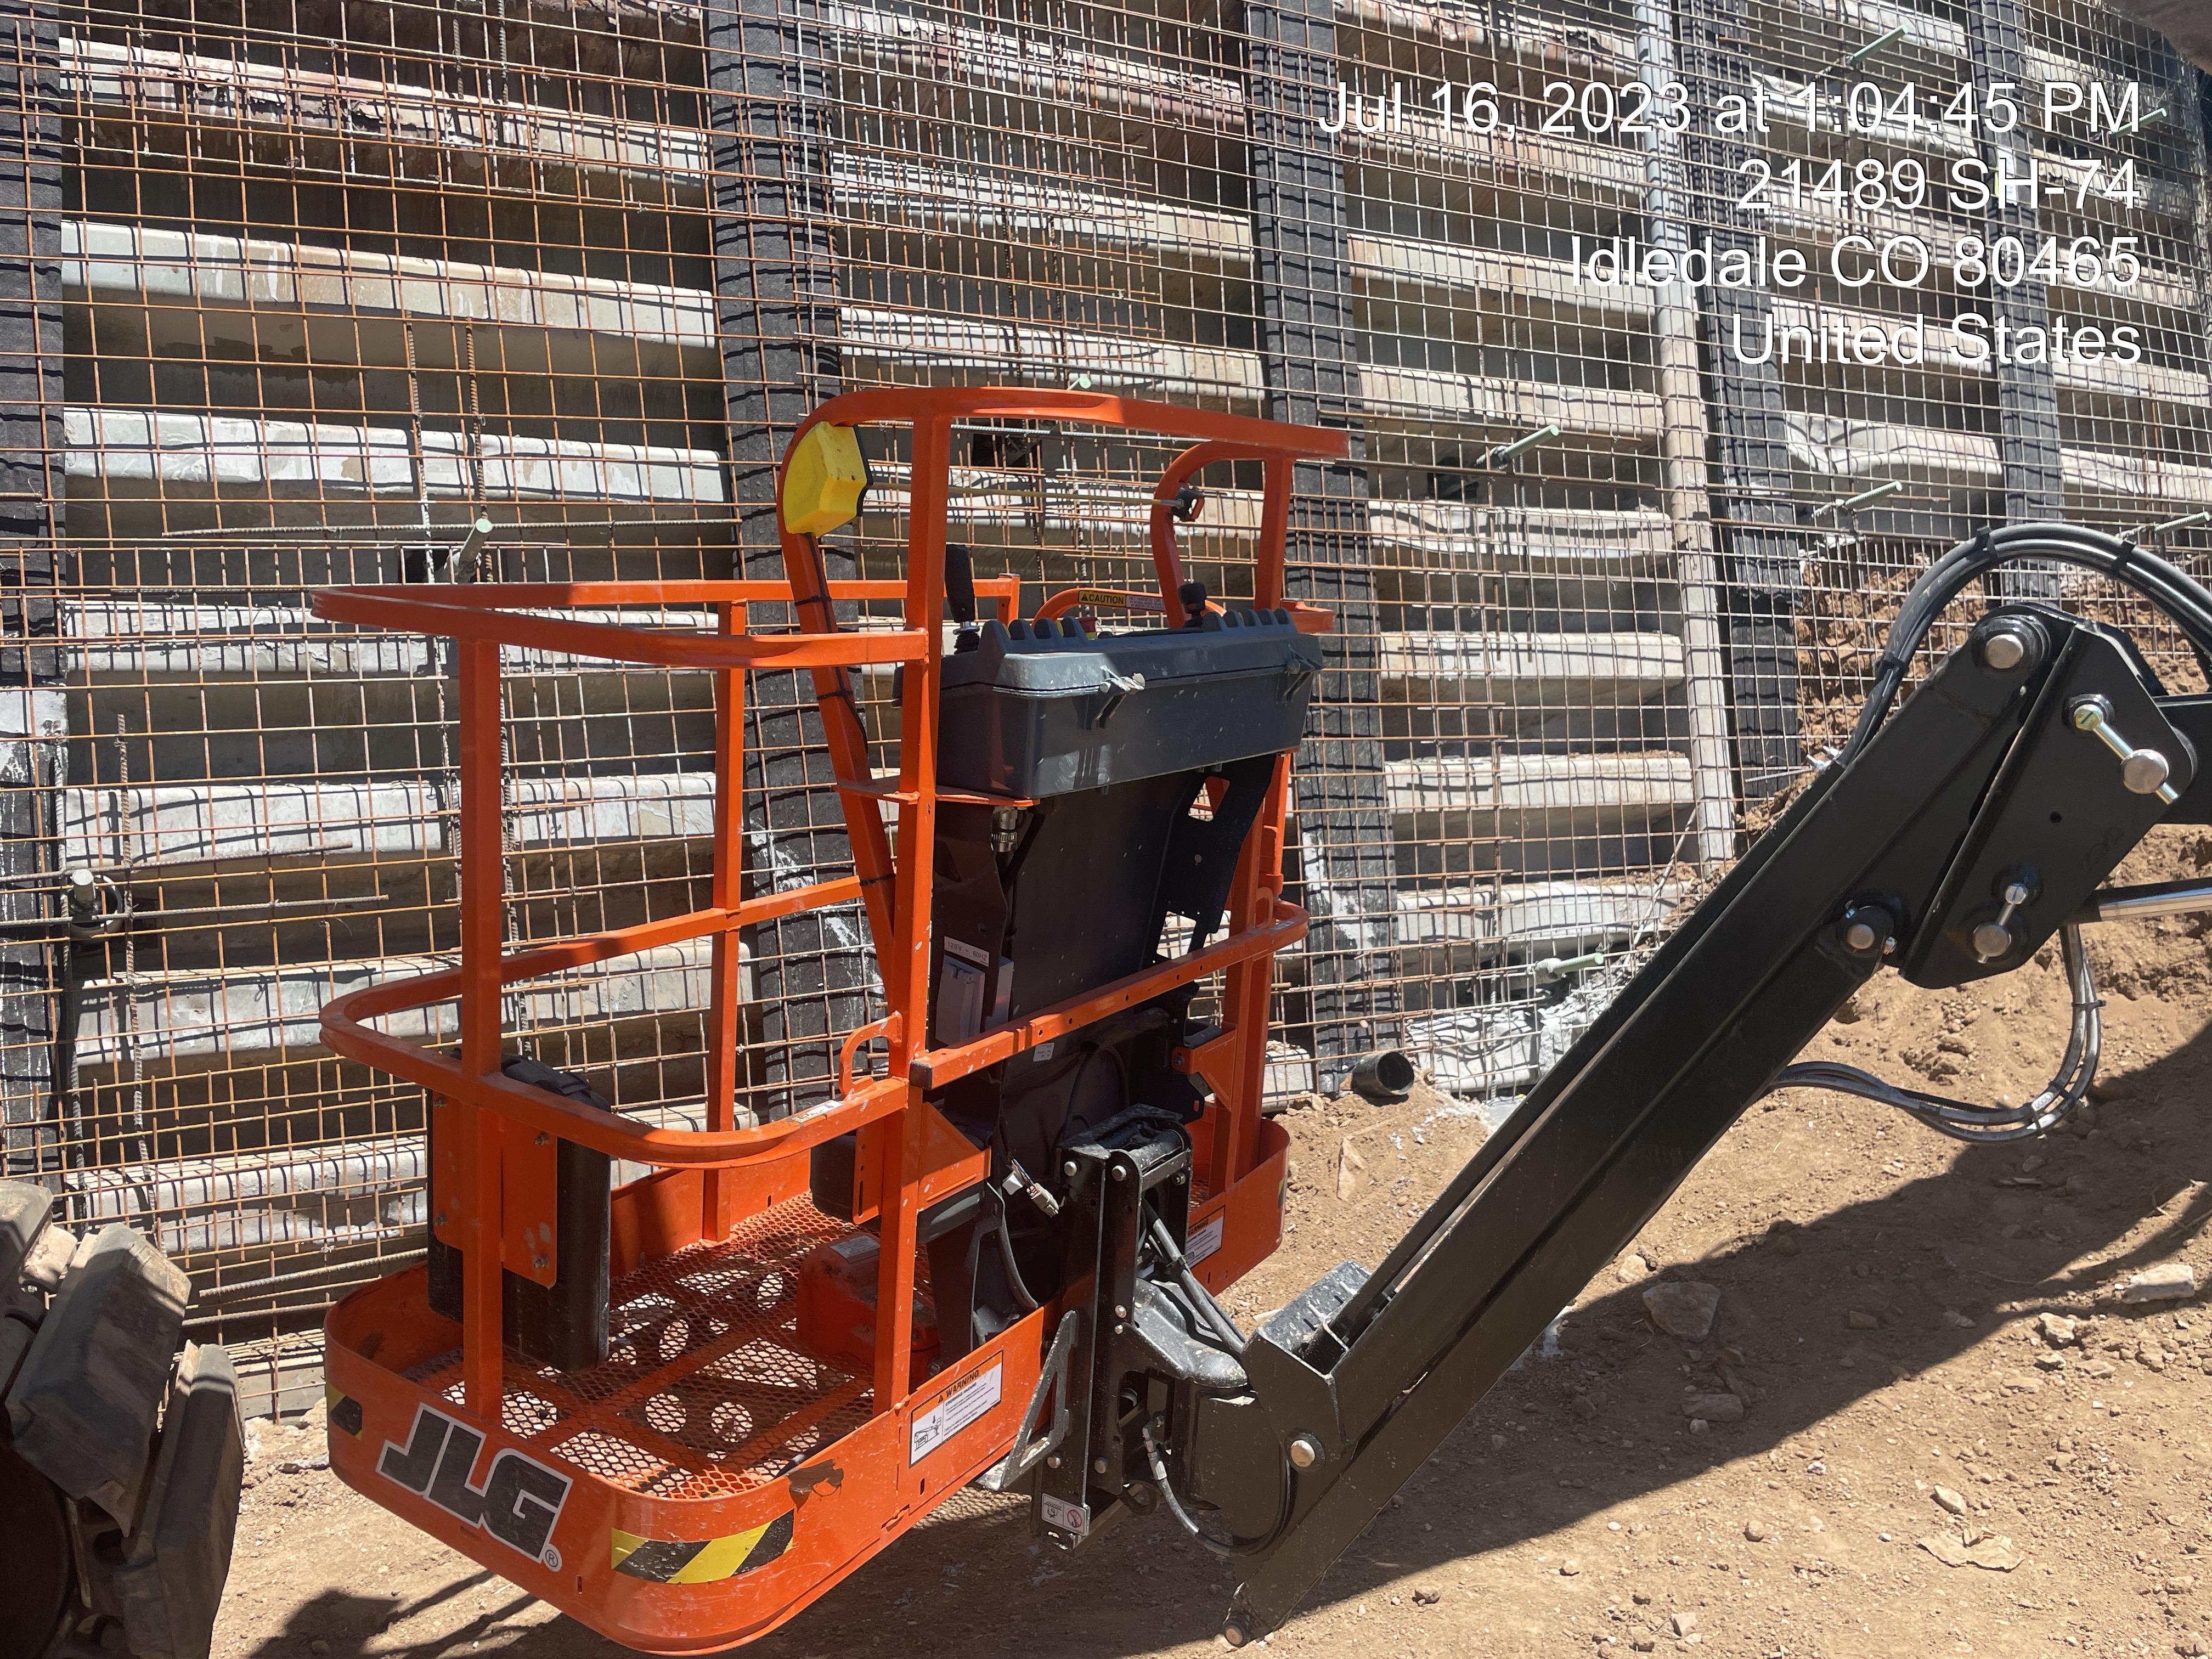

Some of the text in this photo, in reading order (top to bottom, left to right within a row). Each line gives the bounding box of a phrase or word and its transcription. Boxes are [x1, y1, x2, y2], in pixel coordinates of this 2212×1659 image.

[1089, 594, 1124, 605] CAUTION
[947, 940, 962, 951] 120V
[973, 950, 988, 961] 60HZ
[945, 1369, 979, 1398] WARNING
[945, 1382, 977, 1406] CRUSHING HAZARD
[375, 1402, 573, 1564] JLG
